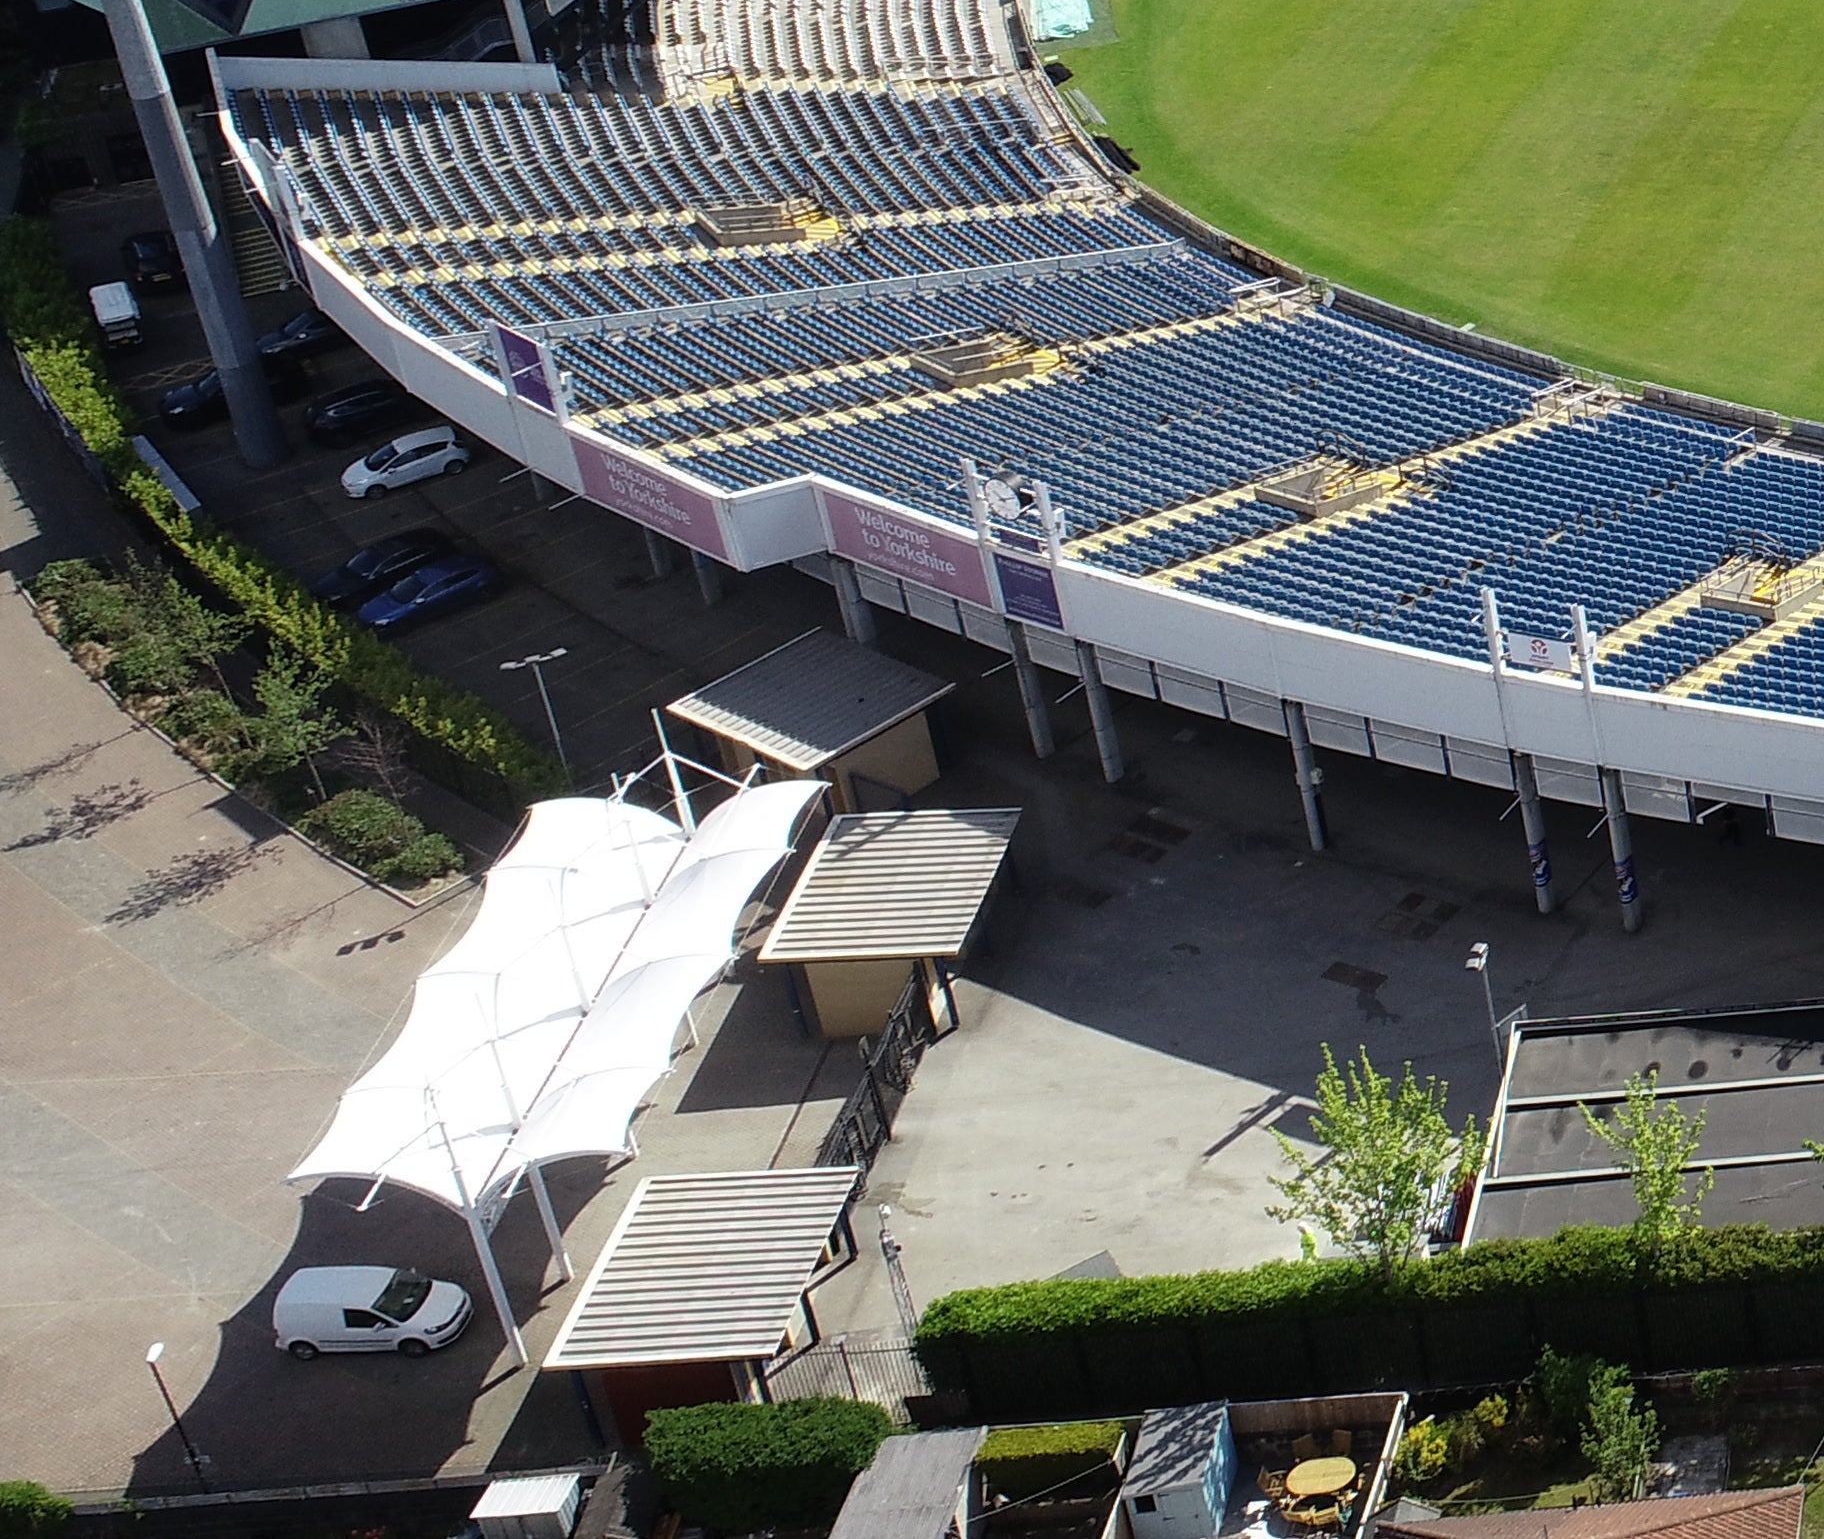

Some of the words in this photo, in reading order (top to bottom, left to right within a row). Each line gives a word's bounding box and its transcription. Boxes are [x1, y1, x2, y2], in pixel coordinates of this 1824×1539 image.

[603, 455, 667, 496] Welcome
[609, 474, 625, 495] to
[625, 481, 692, 525] Yorkshire
[856, 508, 930, 548] Welcome
[862, 528, 880, 548] to
[881, 532, 956, 575] Yorkshire
